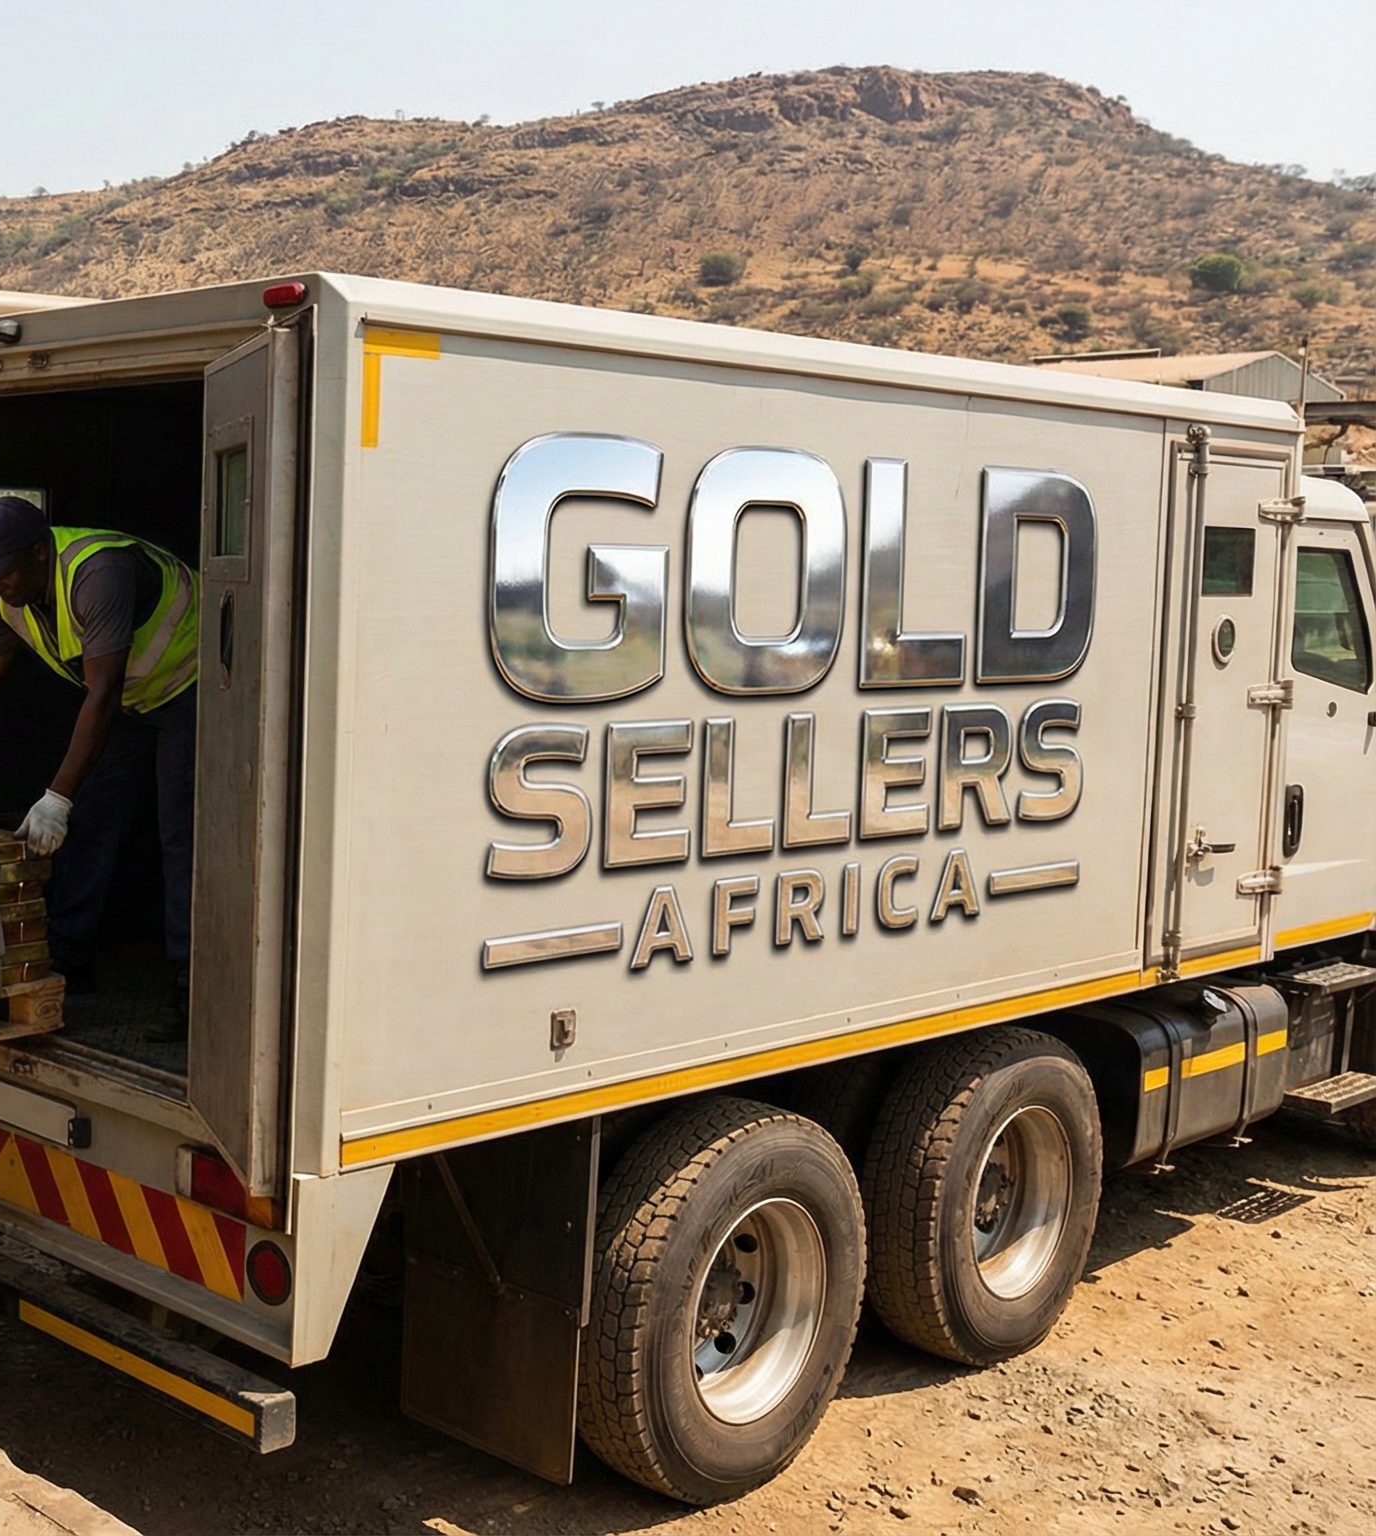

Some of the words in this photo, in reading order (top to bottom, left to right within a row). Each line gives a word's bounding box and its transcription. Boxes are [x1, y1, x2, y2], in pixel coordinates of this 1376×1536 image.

[490, 431, 1098, 703] GOLD
[486, 697, 1084, 878] SELLERS
[630, 848, 980, 969] AFRICA
